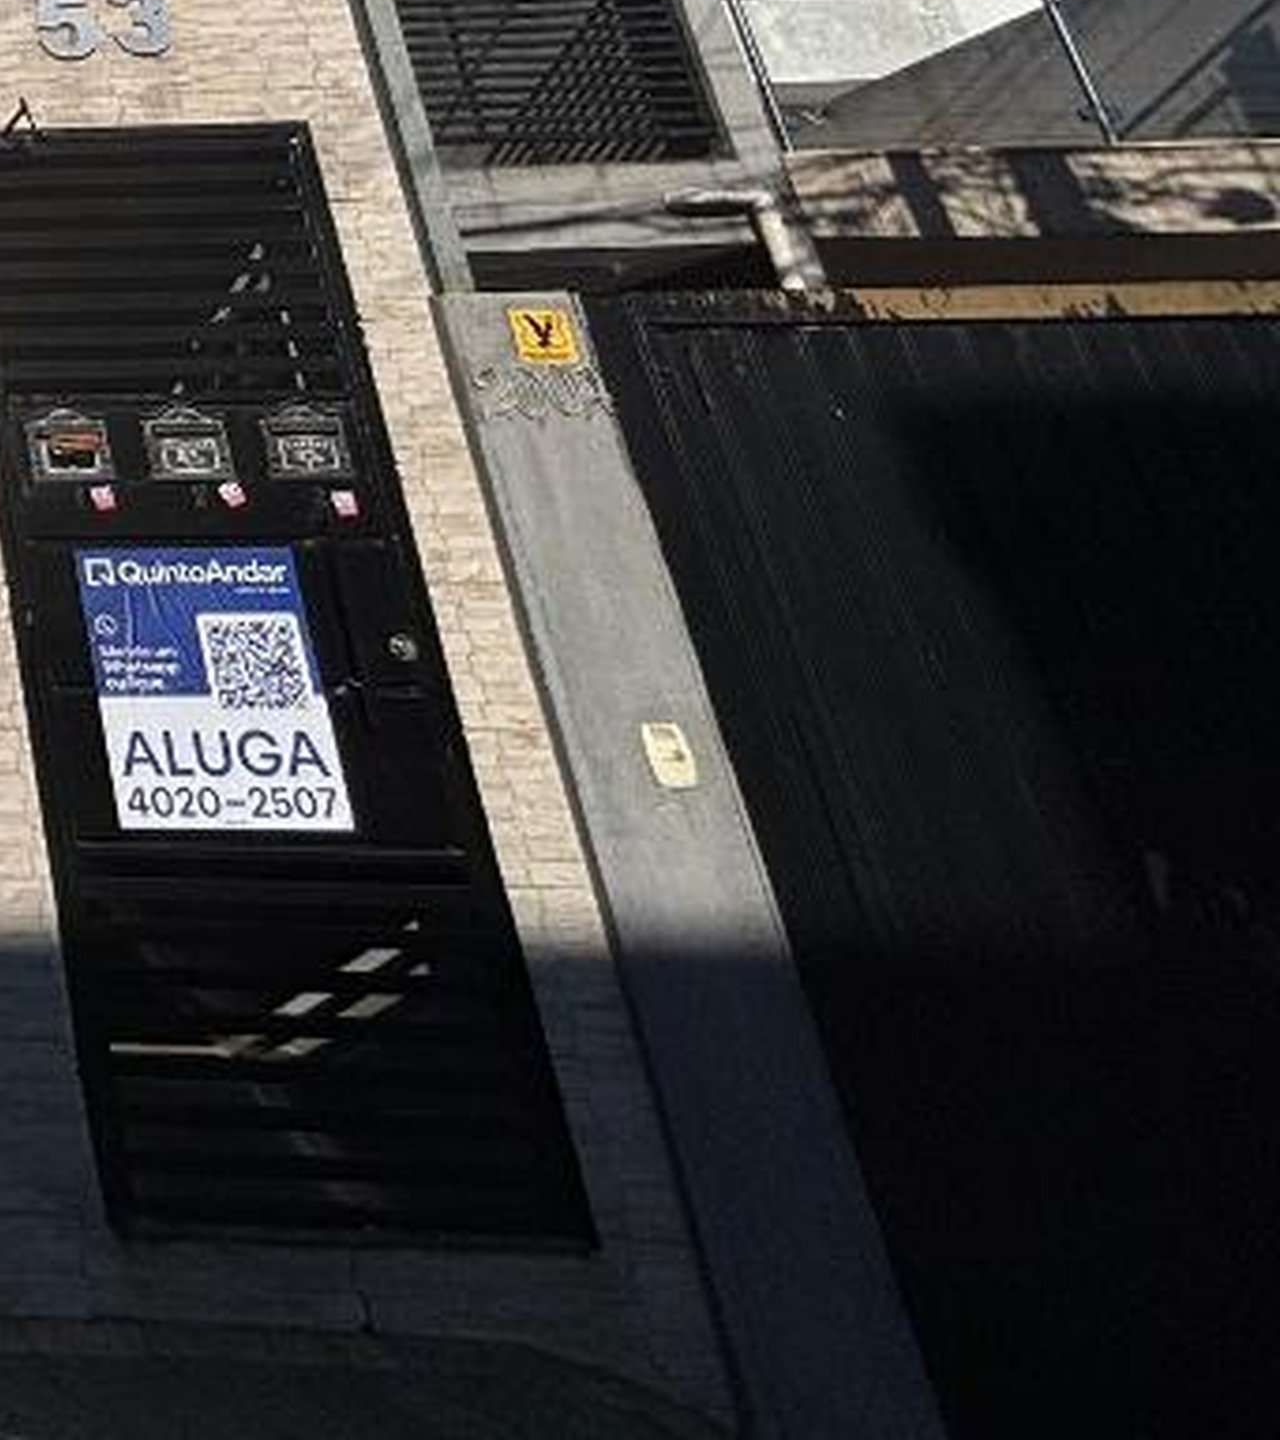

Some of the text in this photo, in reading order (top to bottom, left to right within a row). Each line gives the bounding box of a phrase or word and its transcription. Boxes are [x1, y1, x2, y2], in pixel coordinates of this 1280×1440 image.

[117, 558, 288, 585] QuintoAndar
[122, 729, 332, 777] ALUGA
[127, 786, 337, 818] 4020-2507
